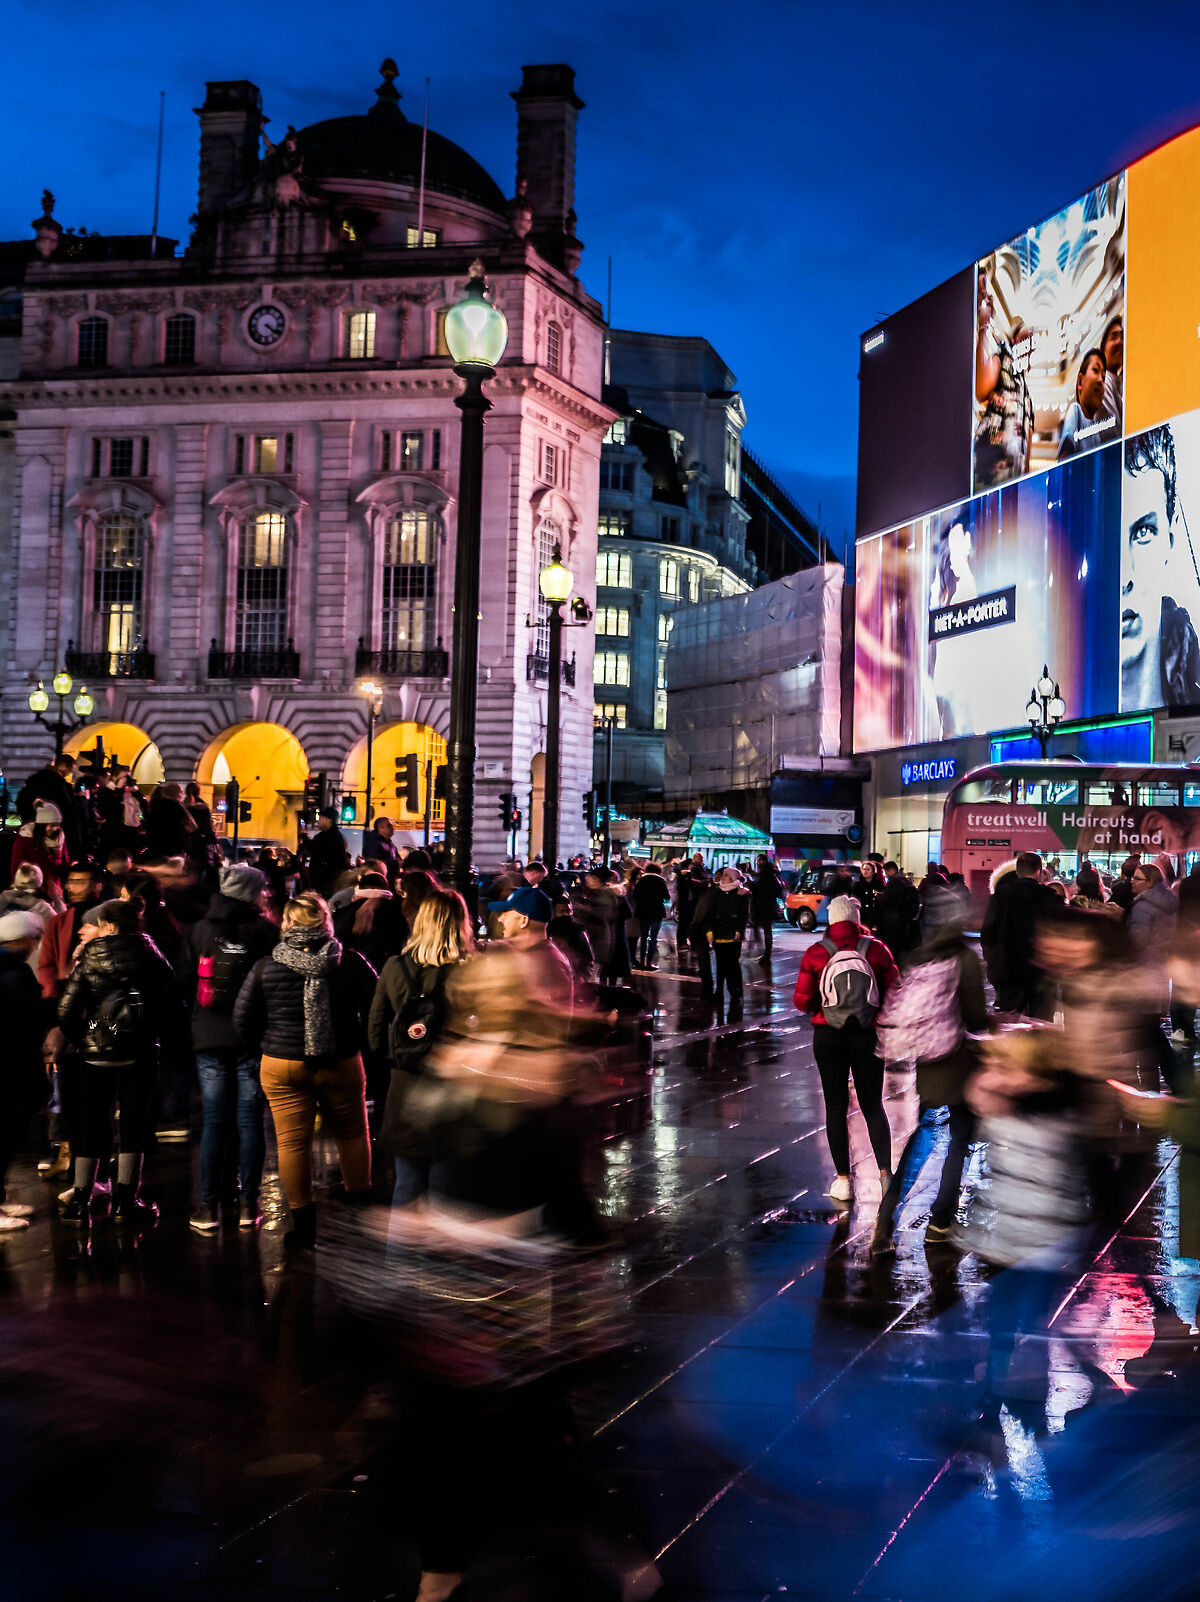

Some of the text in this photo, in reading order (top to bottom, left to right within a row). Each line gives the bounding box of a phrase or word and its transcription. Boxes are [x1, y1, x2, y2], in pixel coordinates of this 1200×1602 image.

[911, 759, 956, 782] BARCLAYS
[967, 811, 1047, 827] treatwell
[1062, 812, 1135, 828] Haircuts
[1094, 829, 1162, 844] at hand
